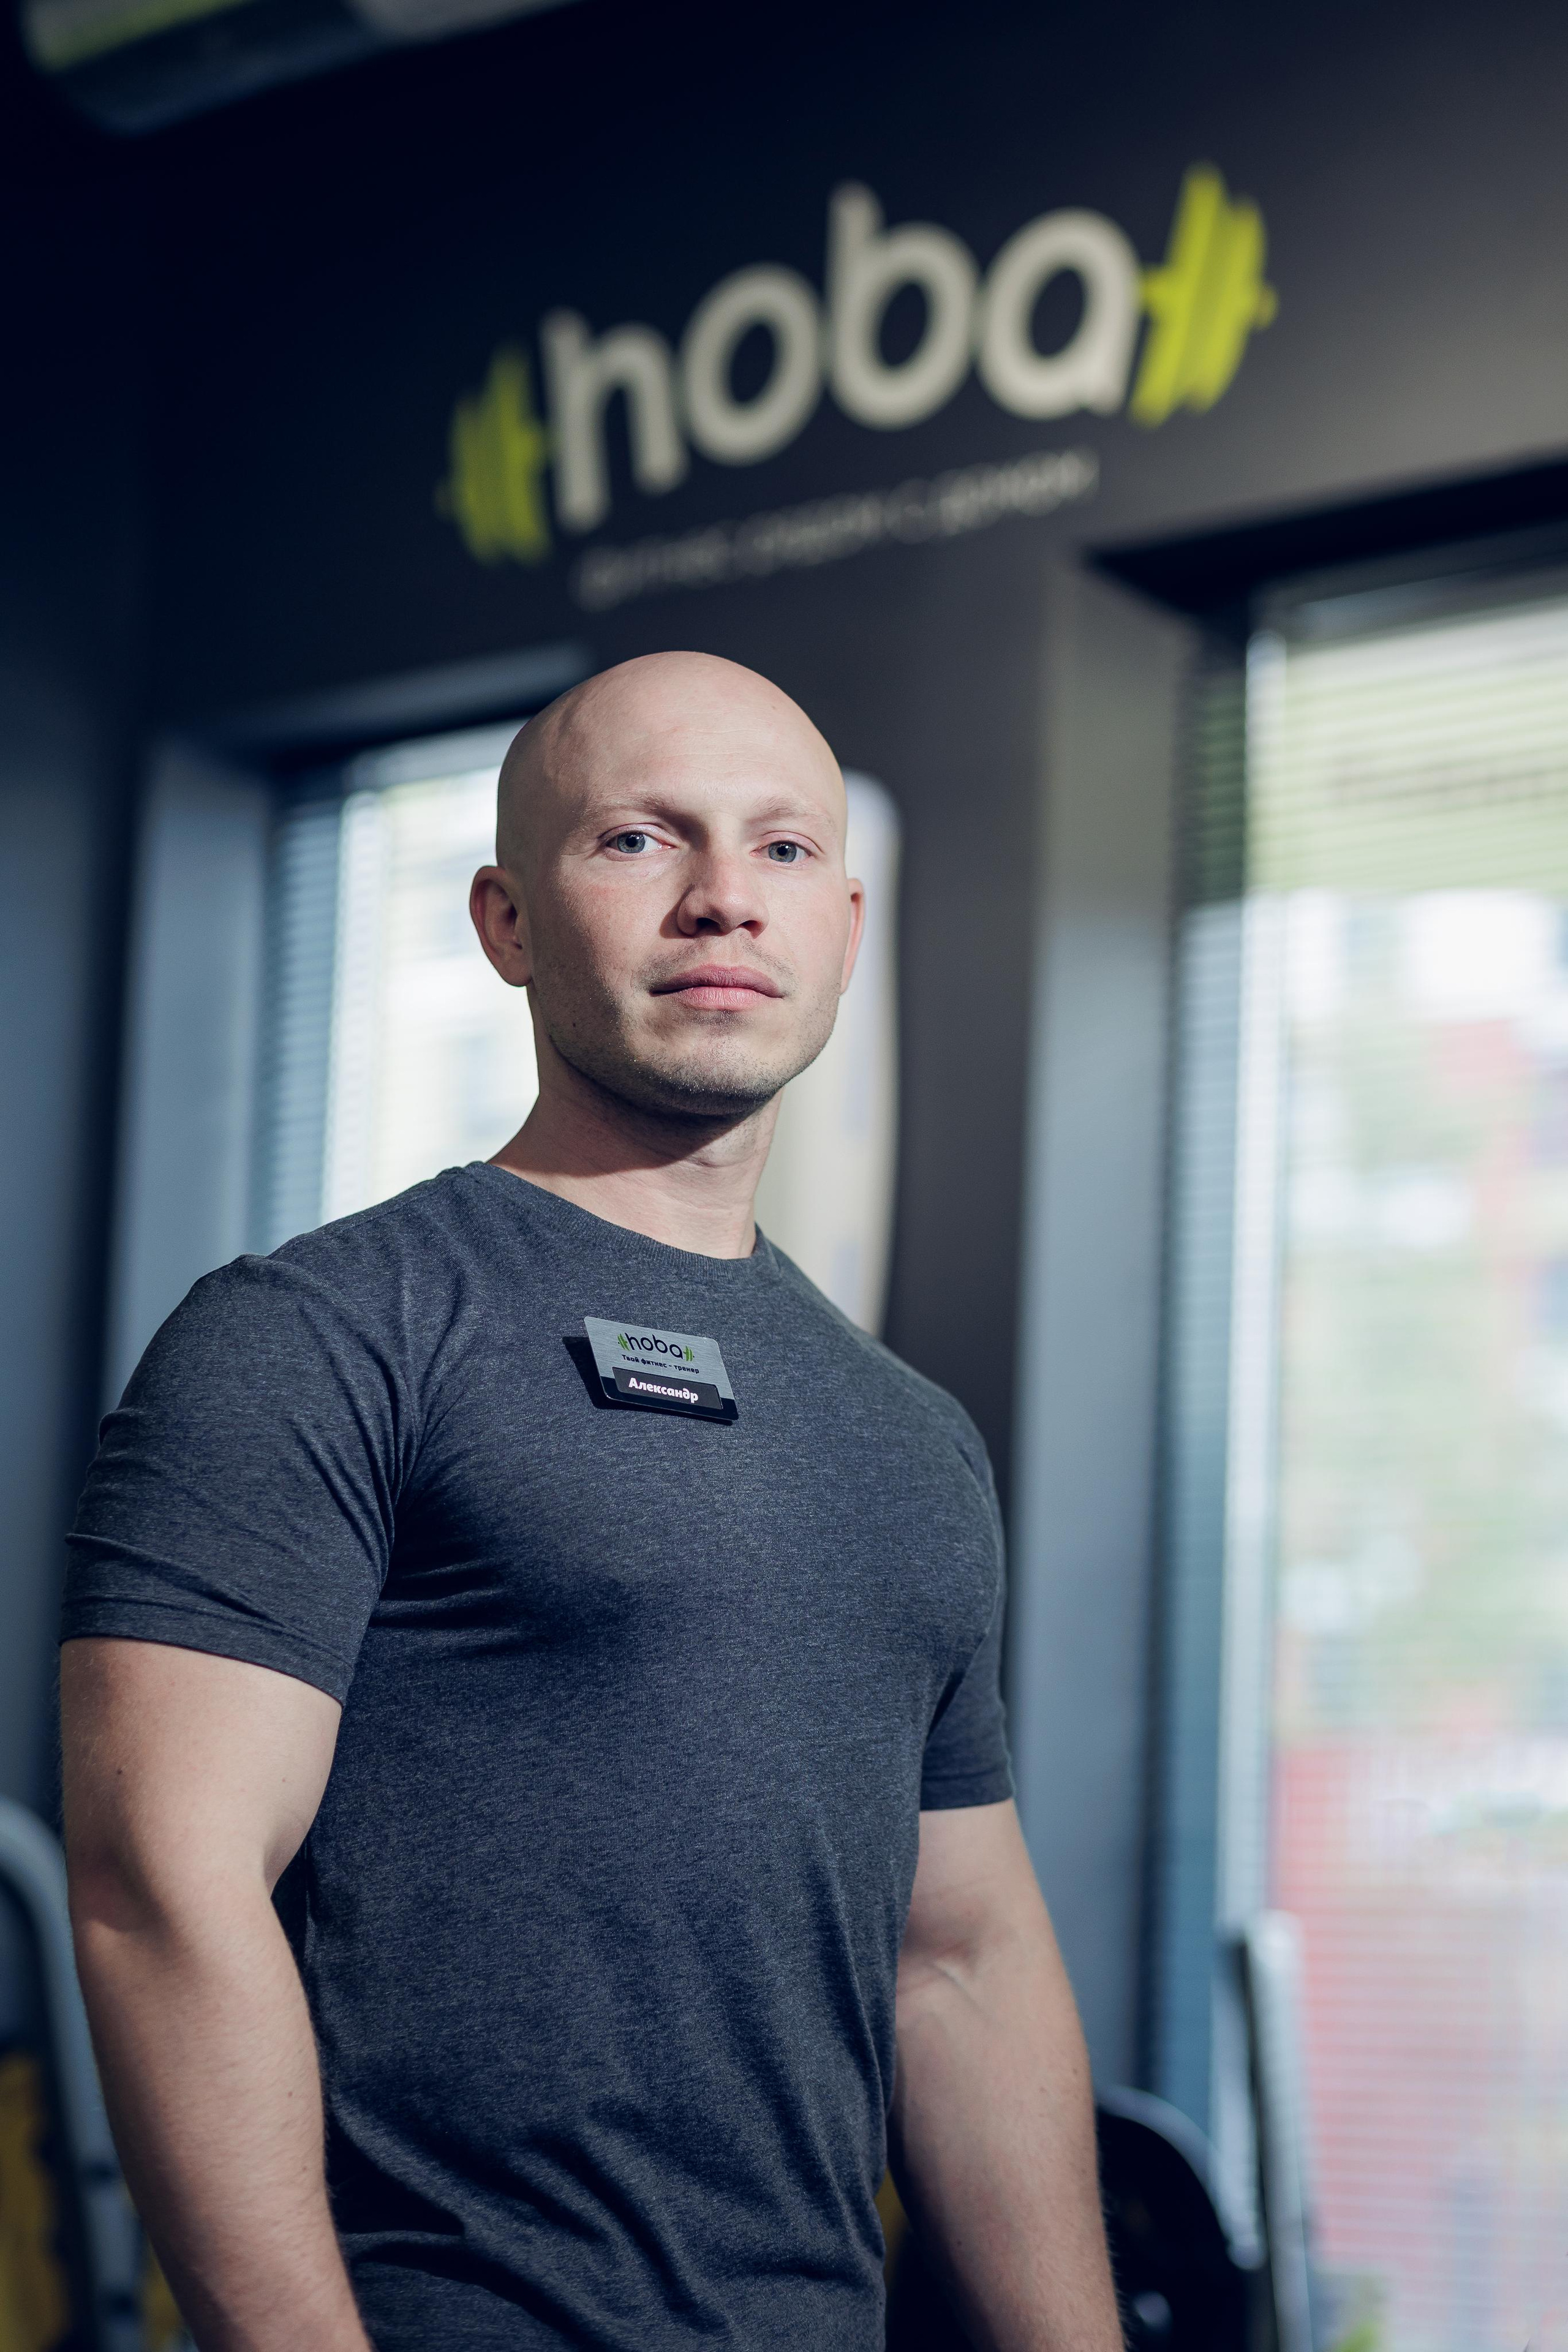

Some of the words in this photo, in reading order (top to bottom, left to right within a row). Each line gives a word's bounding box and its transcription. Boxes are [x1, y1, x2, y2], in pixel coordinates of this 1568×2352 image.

[622, 1354, 639, 1363] Твой
[641, 1358, 668, 1368] фитнес
[674, 1365, 699, 1374] тренер
[628, 1378, 699, 1404] Александр
